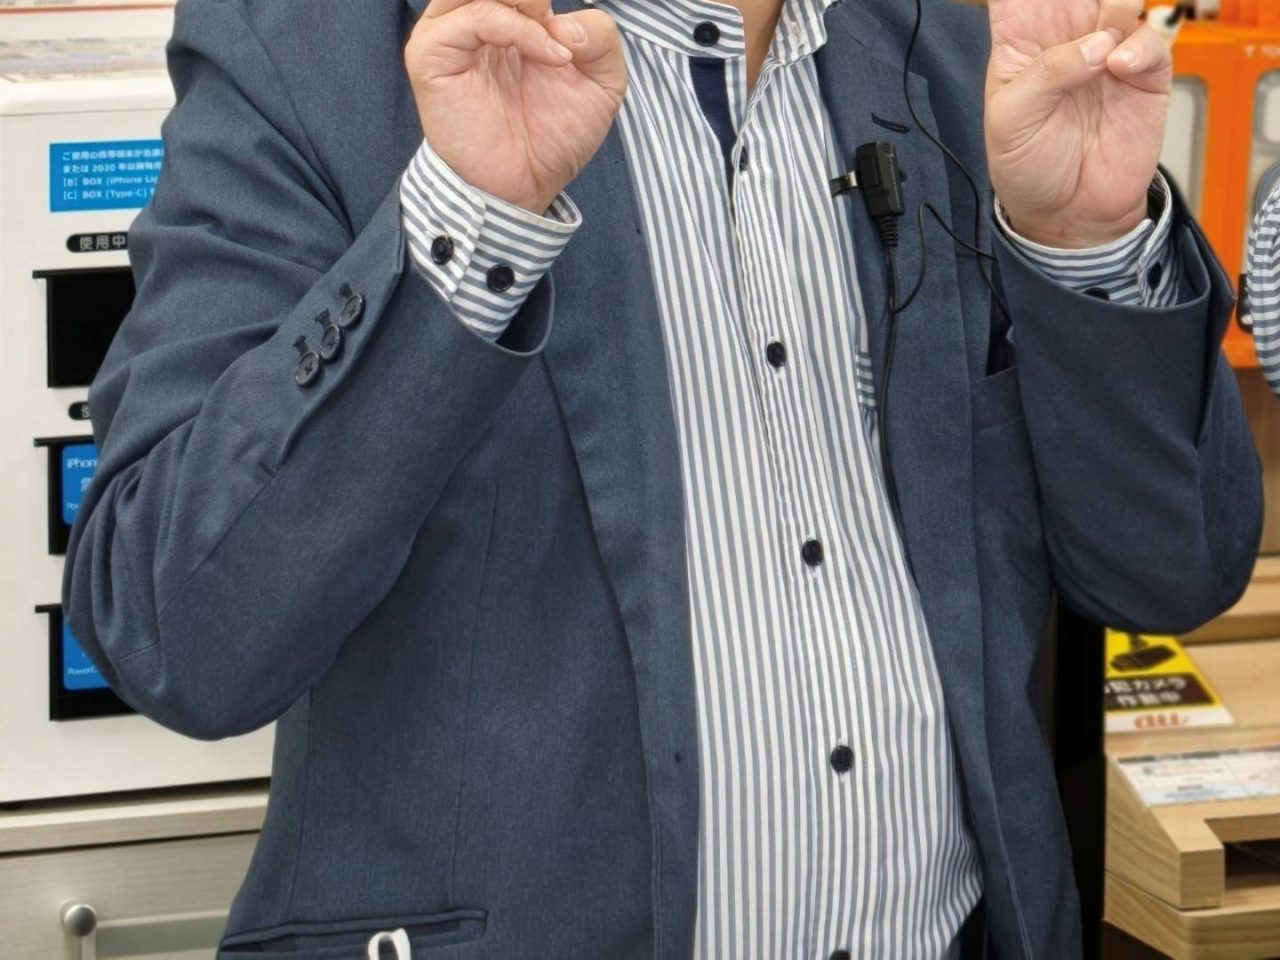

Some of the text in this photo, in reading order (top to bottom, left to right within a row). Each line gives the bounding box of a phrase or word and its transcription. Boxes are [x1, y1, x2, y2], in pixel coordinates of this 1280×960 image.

[82, 177, 103, 186] BOX
[82, 190, 103, 199] BOX
[105, 187, 148, 199] (Type-C)
[79, 234, 126, 250] 使用中
[66, 458, 97, 469] iPhon
